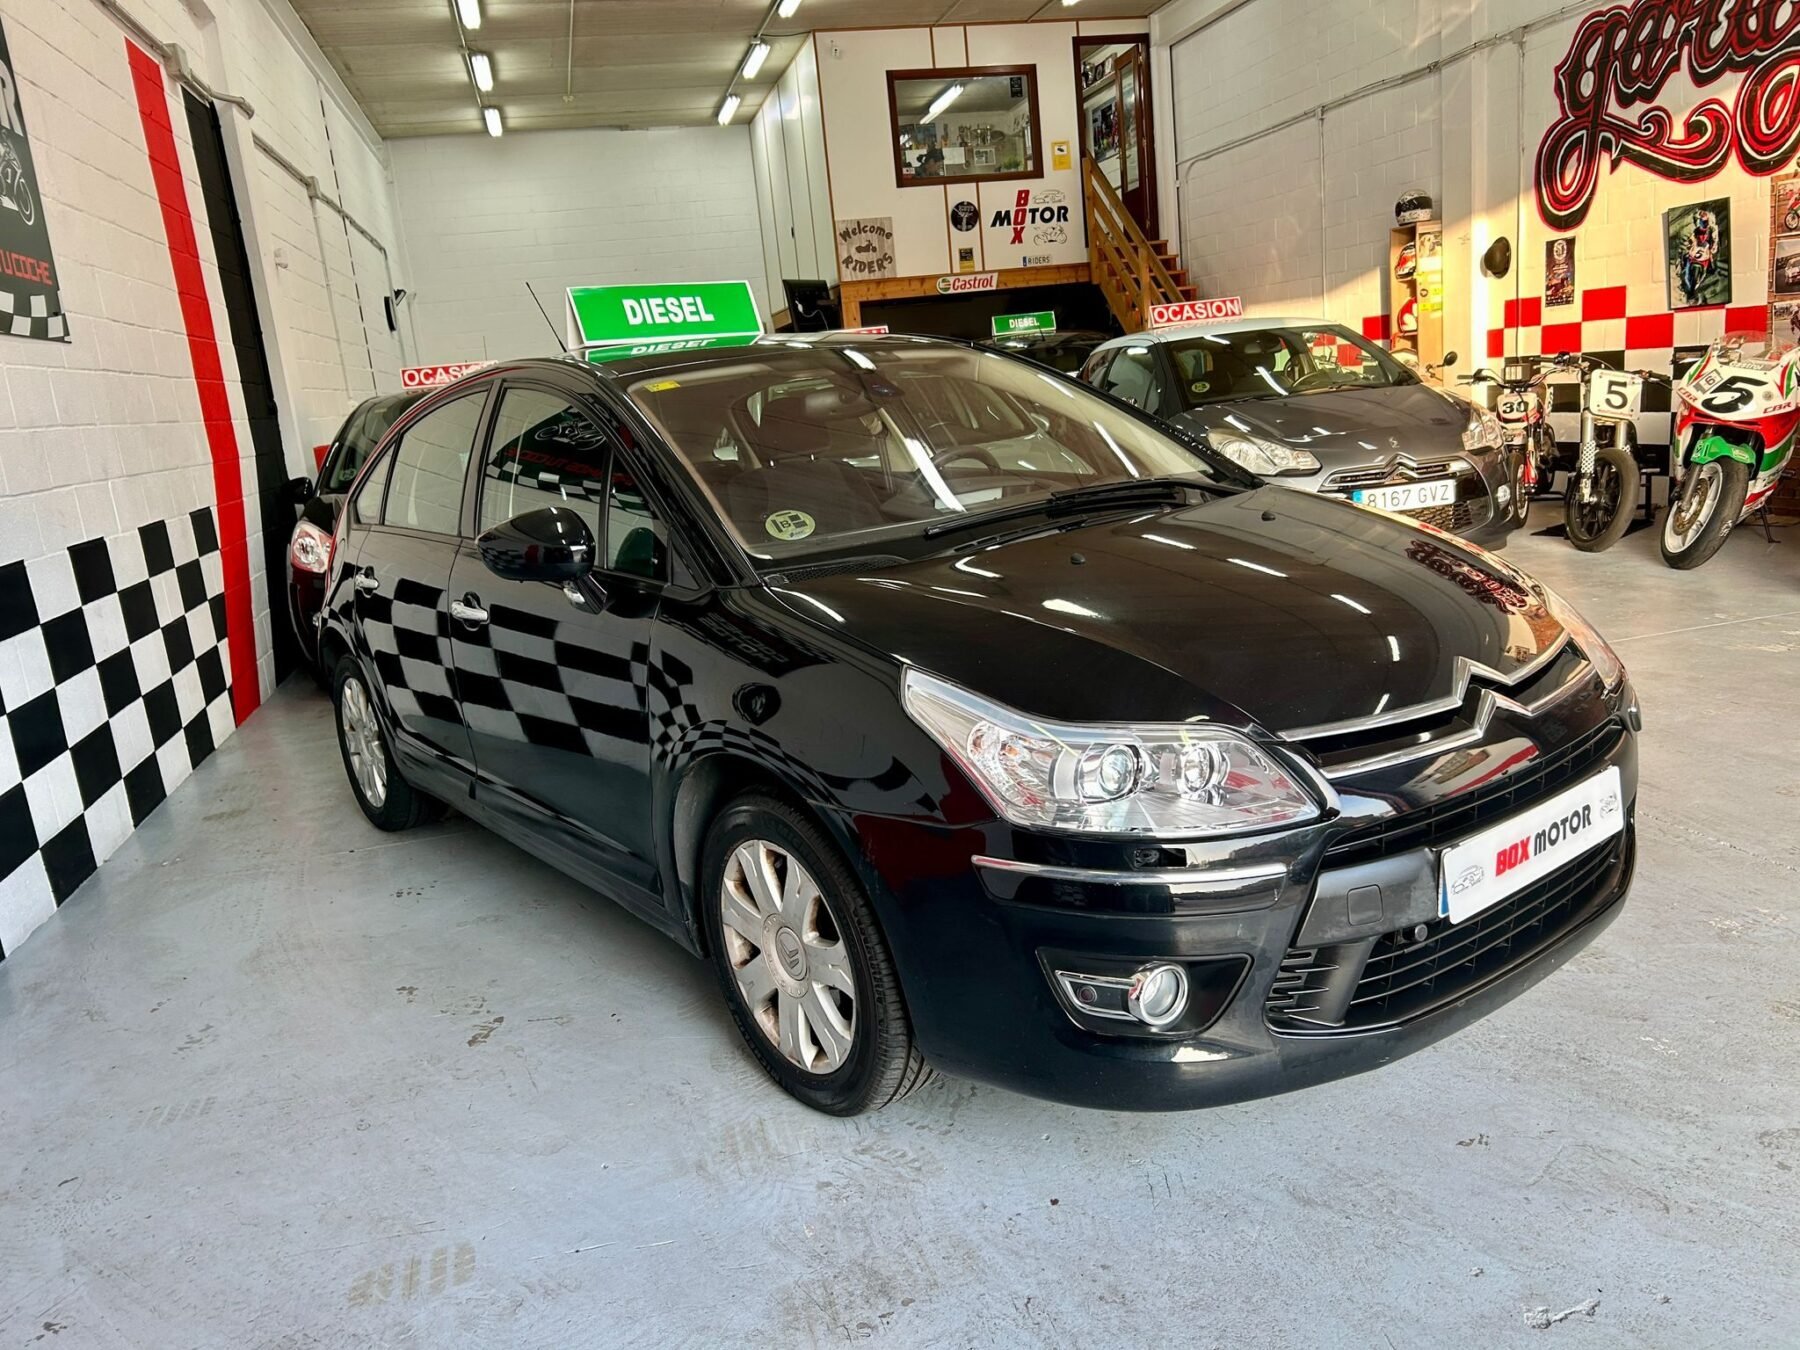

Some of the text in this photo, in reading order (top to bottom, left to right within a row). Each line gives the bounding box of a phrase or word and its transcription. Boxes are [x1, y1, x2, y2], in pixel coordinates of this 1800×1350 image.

[1010, 189, 1030, 244] BOX
[839, 220, 893, 243] Welcome
[841, 252, 893, 274] RIDERS
[1028, 256, 1051, 265] RIDERS
[952, 275, 994, 292] Castrol
[621, 296, 716, 326] DIESEL
[1153, 299, 1240, 323] OCASION
[1008, 317, 1040, 329] DIESEL
[1605, 379, 1628, 410] 5
[1701, 375, 1769, 414] 5
[1502, 401, 1529, 414] 30
[1762, 401, 1792, 414] CBR
[1367, 484, 1449, 508] 8167 GVZ
[1495, 804, 1592, 877] BOX MOTOR
